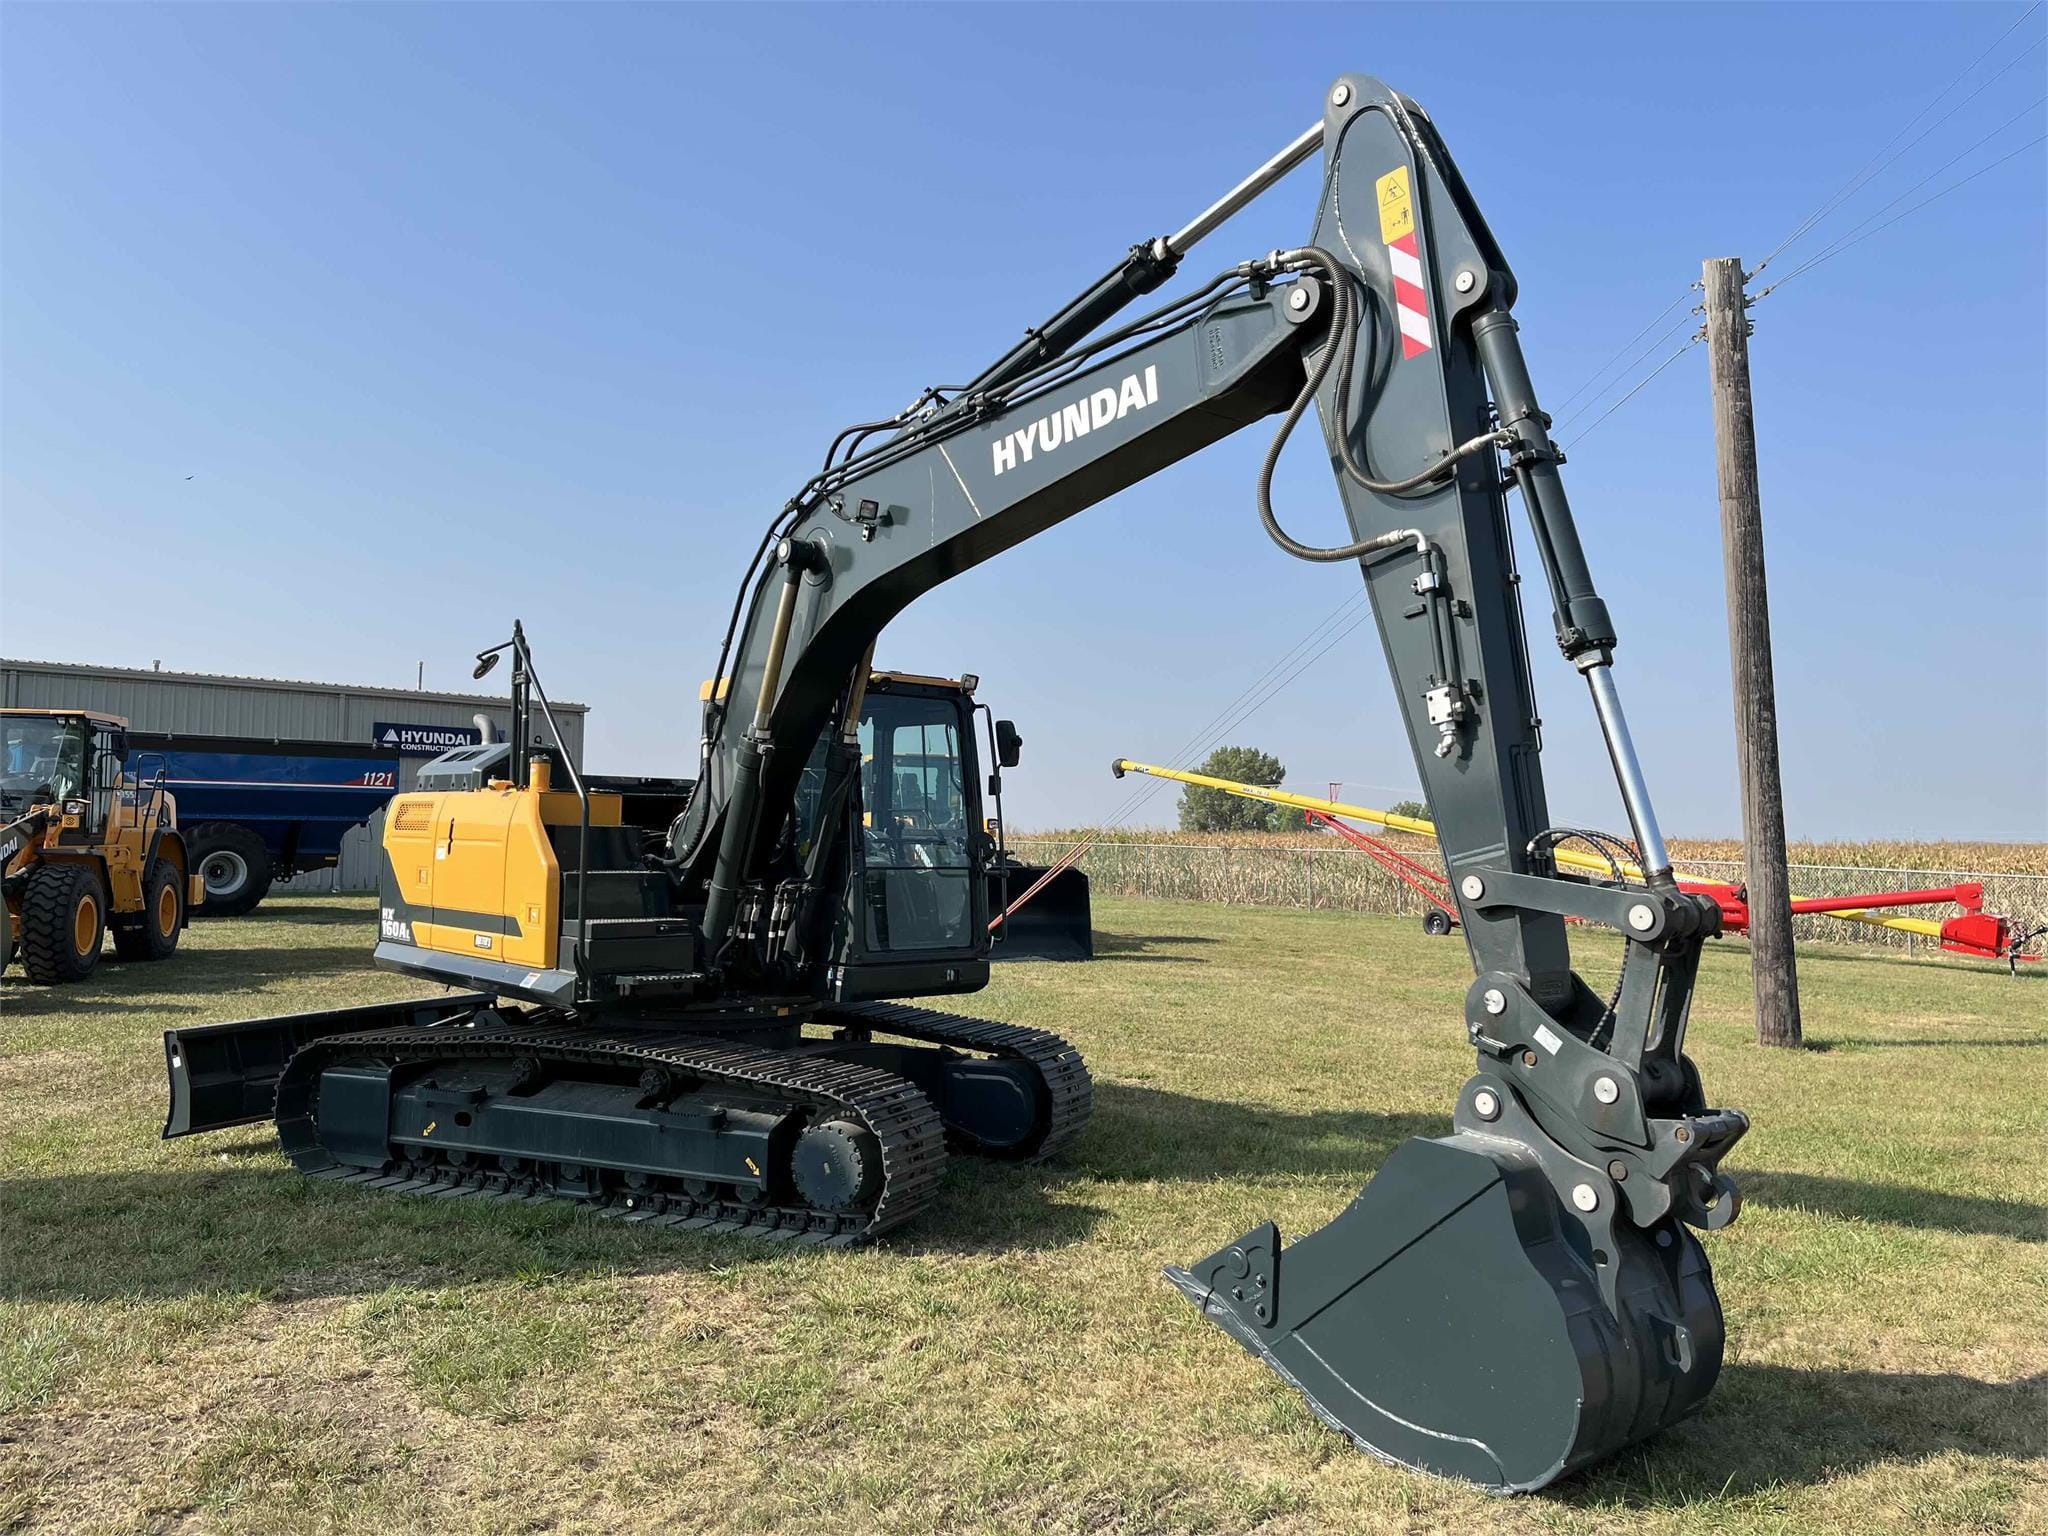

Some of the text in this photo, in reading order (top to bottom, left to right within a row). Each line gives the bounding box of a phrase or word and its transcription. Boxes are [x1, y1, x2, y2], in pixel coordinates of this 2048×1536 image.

[992, 364, 1158, 476] HYUNDAI
[401, 730, 470, 745] HYUNDAI
[363, 771, 393, 785] 1121
[382, 907, 396, 920] HX
